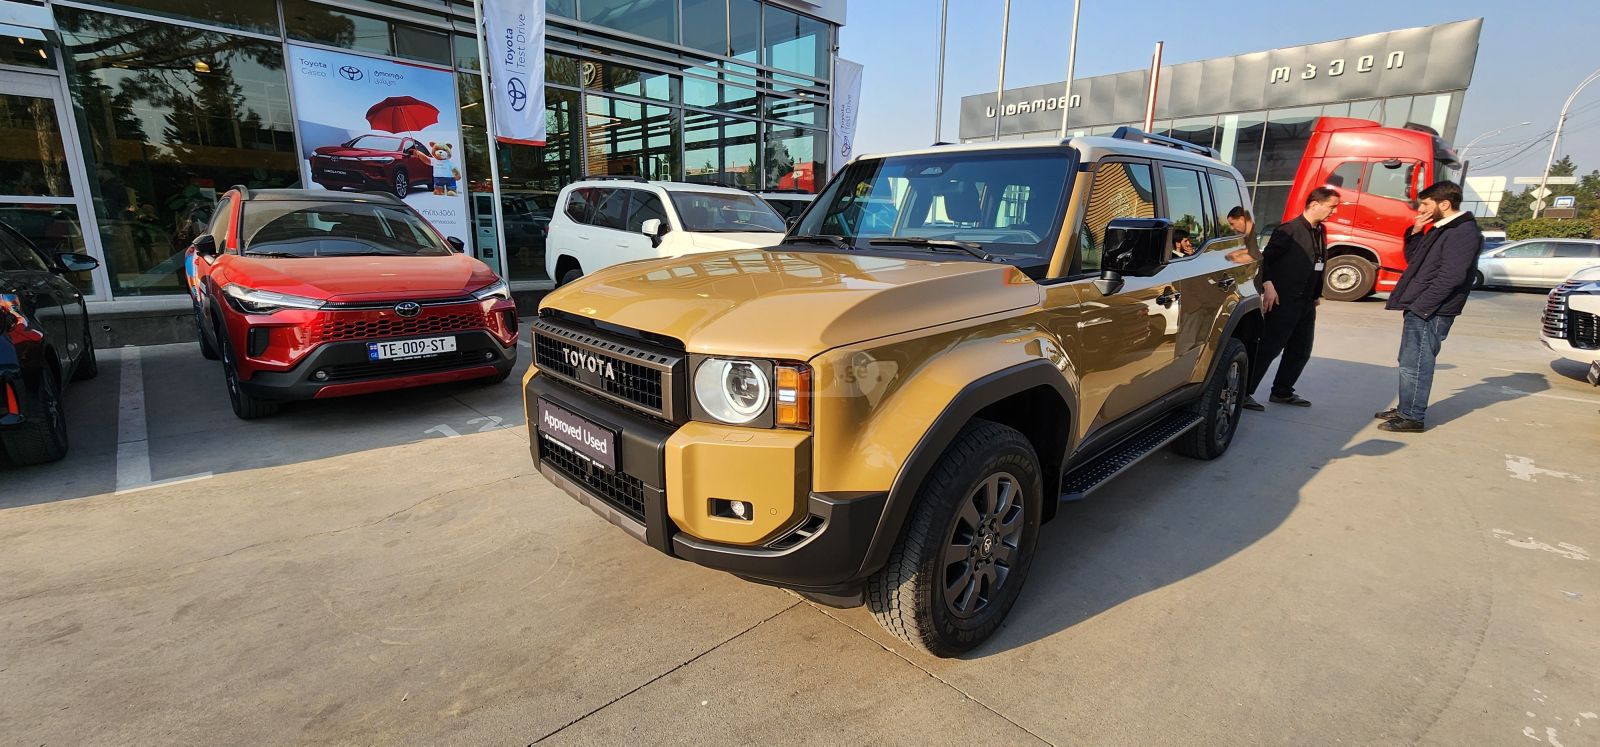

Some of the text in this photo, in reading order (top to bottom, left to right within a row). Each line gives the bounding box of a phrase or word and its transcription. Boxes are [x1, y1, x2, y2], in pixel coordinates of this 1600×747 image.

[505, 28, 516, 66] Toyota
[516, 14, 526, 69] Test Drive
[300, 58, 327, 69] Toyota
[301, 67, 326, 77] Casco
[1270, 50, 1405, 84] ოპელი
[380, 338, 446, 357] TE-009-ST
[562, 347, 615, 381] TOYOTA
[544, 410, 582, 441] Approved
[583, 429, 607, 454] Used
